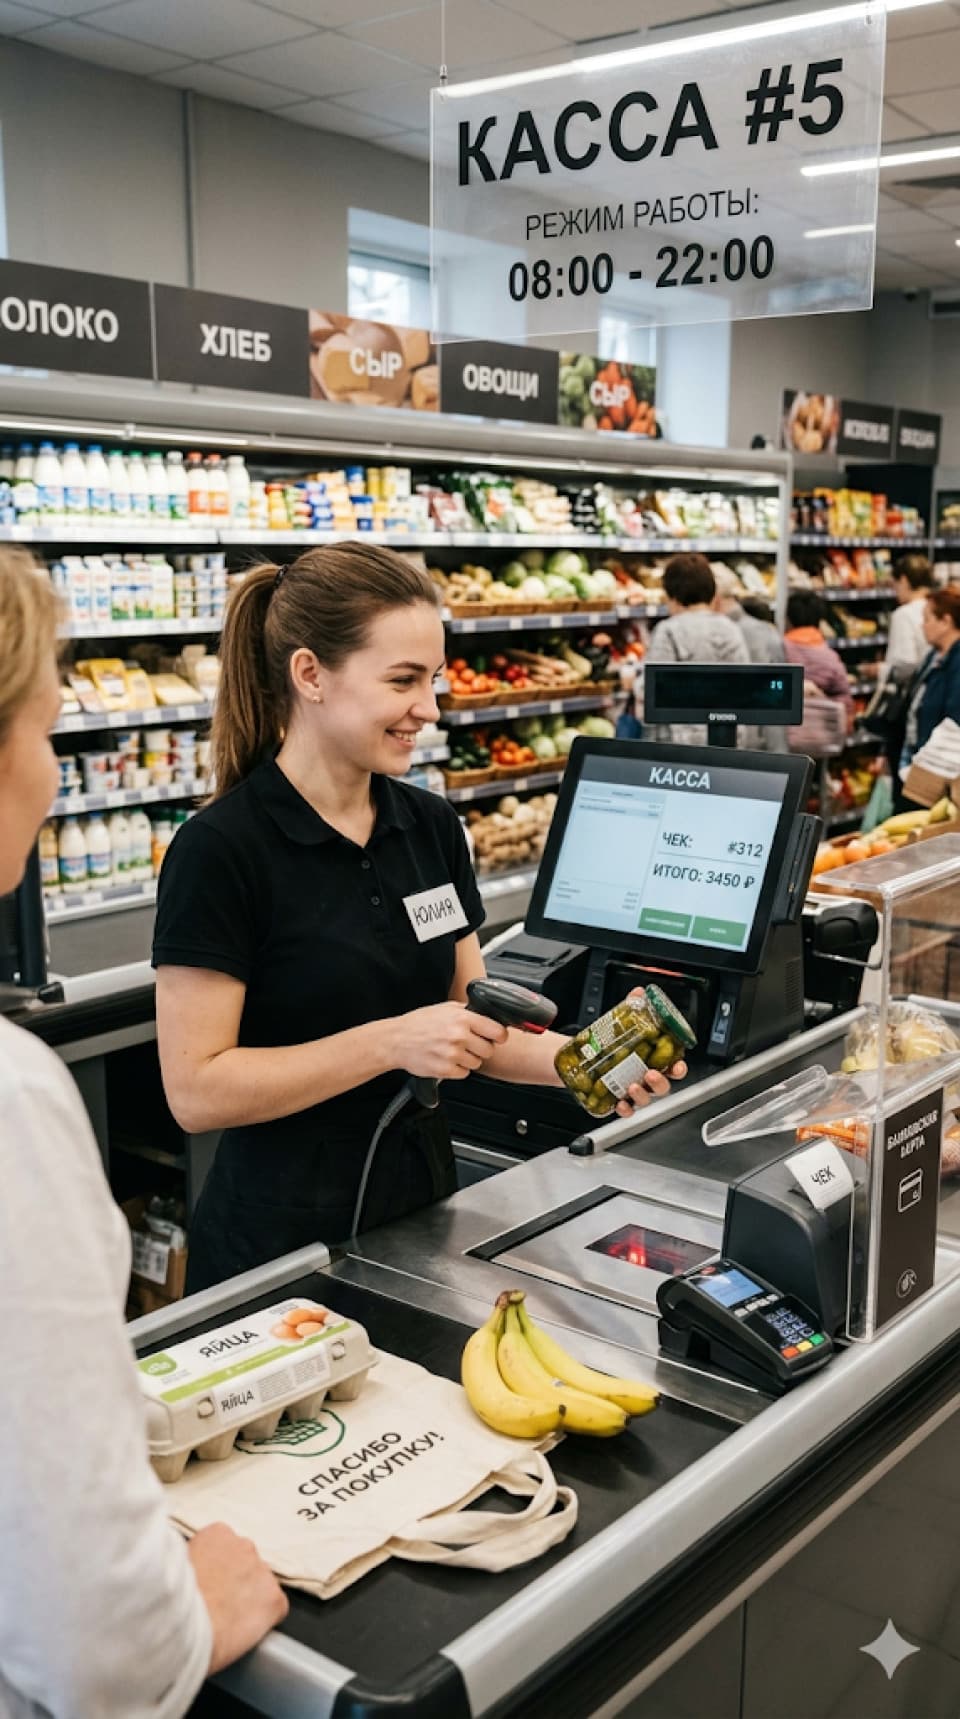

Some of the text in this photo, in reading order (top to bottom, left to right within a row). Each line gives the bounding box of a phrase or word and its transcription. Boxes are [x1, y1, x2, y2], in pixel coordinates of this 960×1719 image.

[458, 58, 844, 186] КАССА #5
[525, 187, 759, 241] РЕЖИМ РАБОТЫ:
[508, 234, 775, 302] 08:00 - 22:00
[0, 296, 119, 343] ОЛОКО
[199, 323, 272, 362] ХЛЕБ
[348, 348, 403, 379] СЫР
[462, 363, 540, 402] ОВОЩИ
[589, 381, 631, 408] СЫР
[649, 766, 711, 790] КАССА
[662, 832, 764, 859] ЧЕК: #312
[652, 863, 703, 884] ИТОГО:
[705, 869, 741, 888] 3450
[412, 897, 456, 927] ЮЛИЯ
[810, 1165, 836, 1185] ЧЕК
[199, 1331, 259, 1358] ЯЙЦА
[220, 1390, 255, 1412] ЯЙЦА
[297, 1431, 445, 1521] ЗА ПОКУПКУ!
[298, 1432, 402, 1496] СПАСИБО
